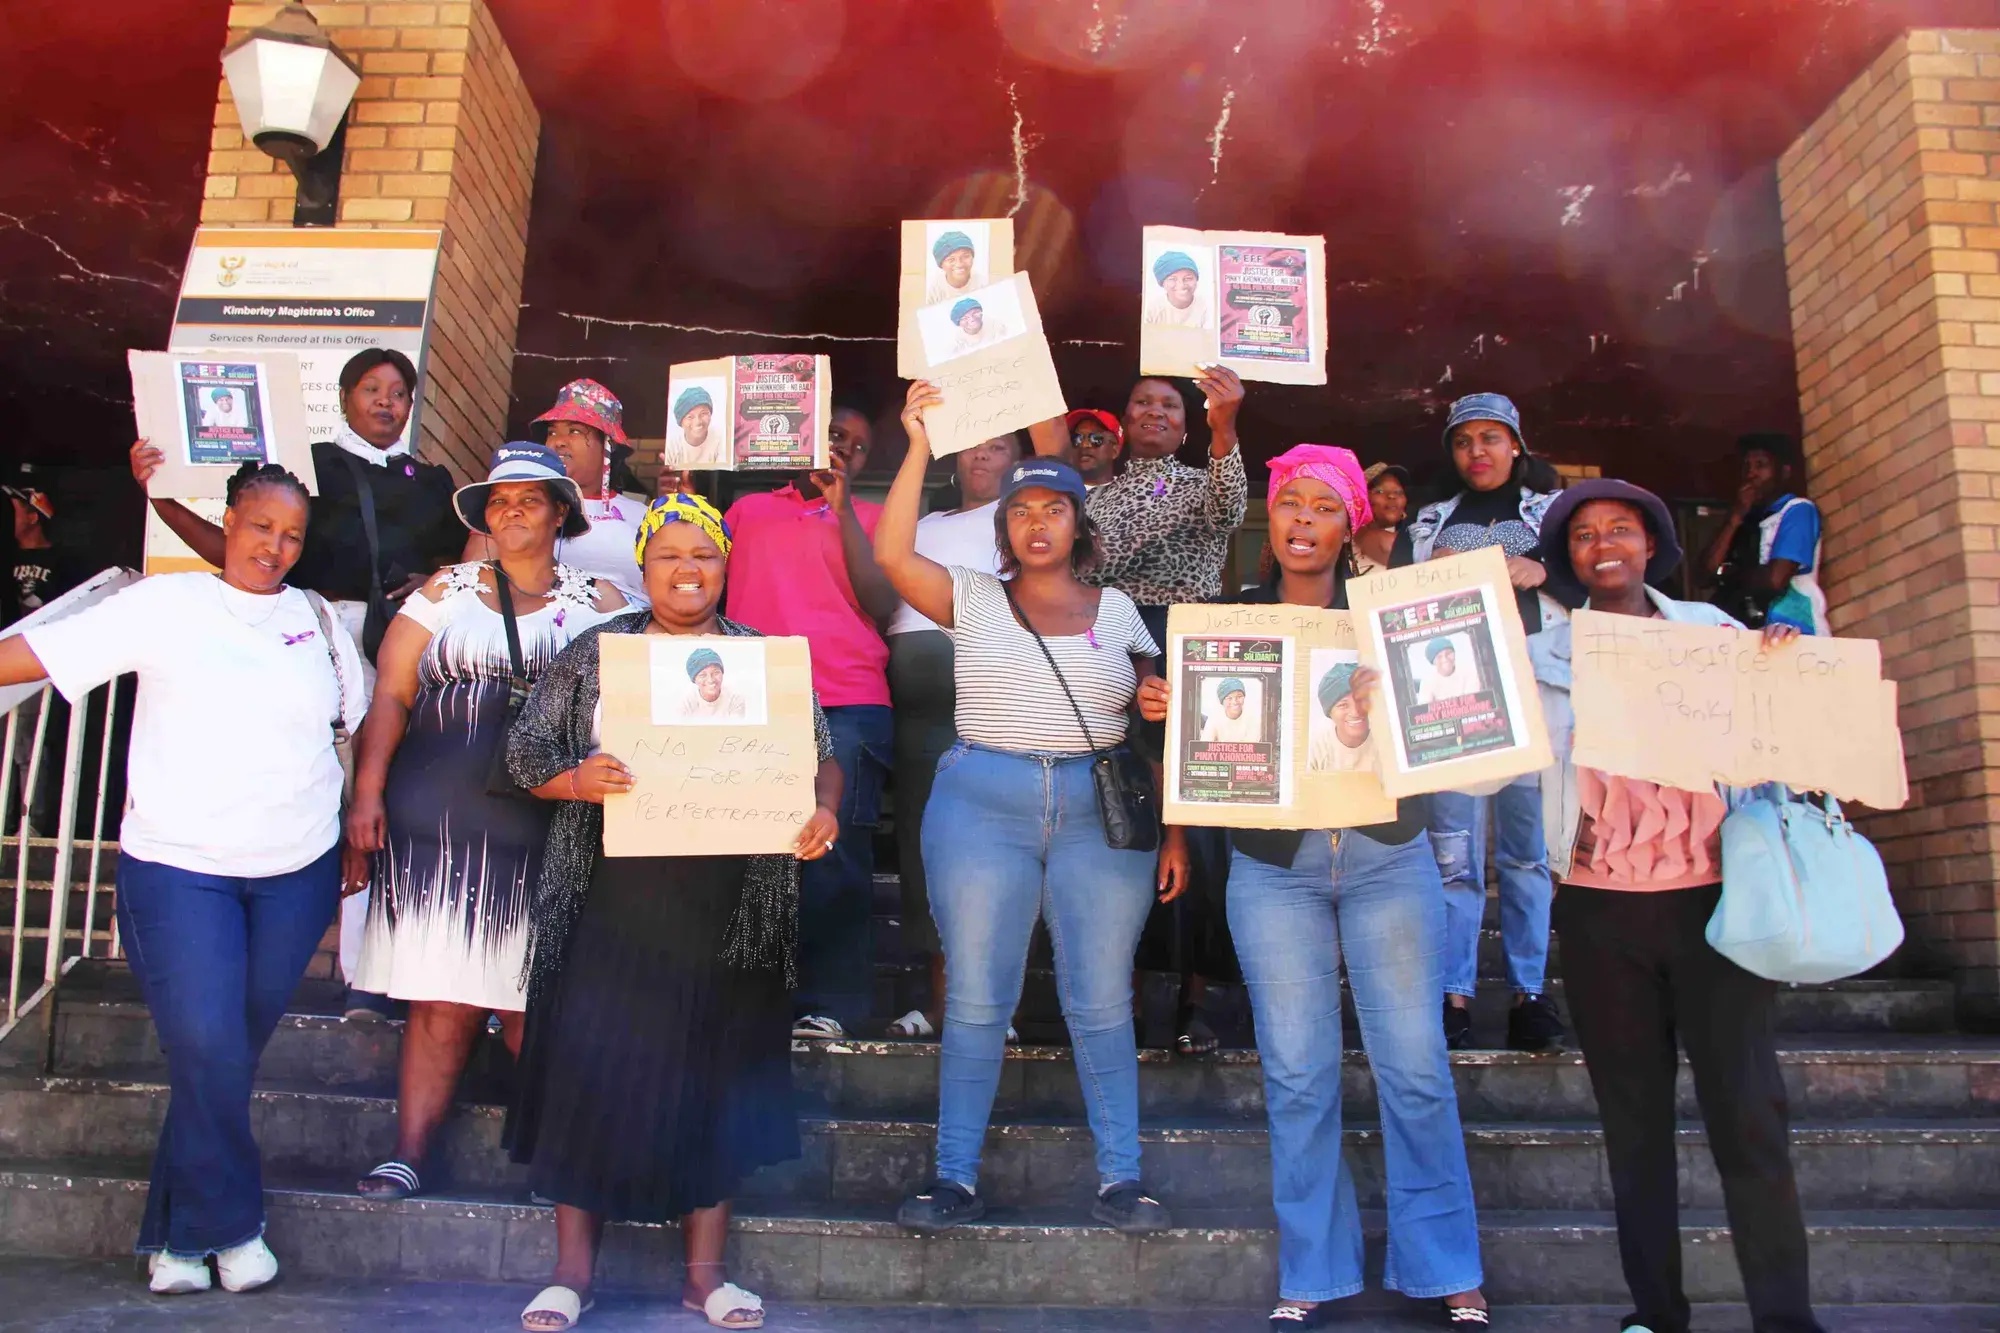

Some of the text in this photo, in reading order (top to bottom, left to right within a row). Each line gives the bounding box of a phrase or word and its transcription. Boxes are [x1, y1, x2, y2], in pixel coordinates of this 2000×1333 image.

[1243, 254, 1262, 263] EFF
[1242, 267, 1269, 276] JUSTICE
[222, 305, 376, 318] Kimberley Magistrate's Office
[209, 333, 380, 346] Services Rendered at this Office:
[300, 362, 314, 370] RT
[758, 362, 775, 370] EFF
[756, 374, 794, 384] JUSTICE FOR
[307, 404, 328, 412] NCE
[206, 514, 222, 524] CH
[1370, 563, 1469, 594] NO BAIL
[1404, 602, 1439, 627] EFF
[1206, 641, 1280, 662] EFF SOLIDARITY
[630, 736, 790, 761] NO BAIL
[1208, 743, 1254, 753] JUSTICE FOR
[1194, 752, 1219, 761] PINKY
[680, 766, 800, 792] FOR THE
[634, 792, 804, 825] PERPERTRATOR
